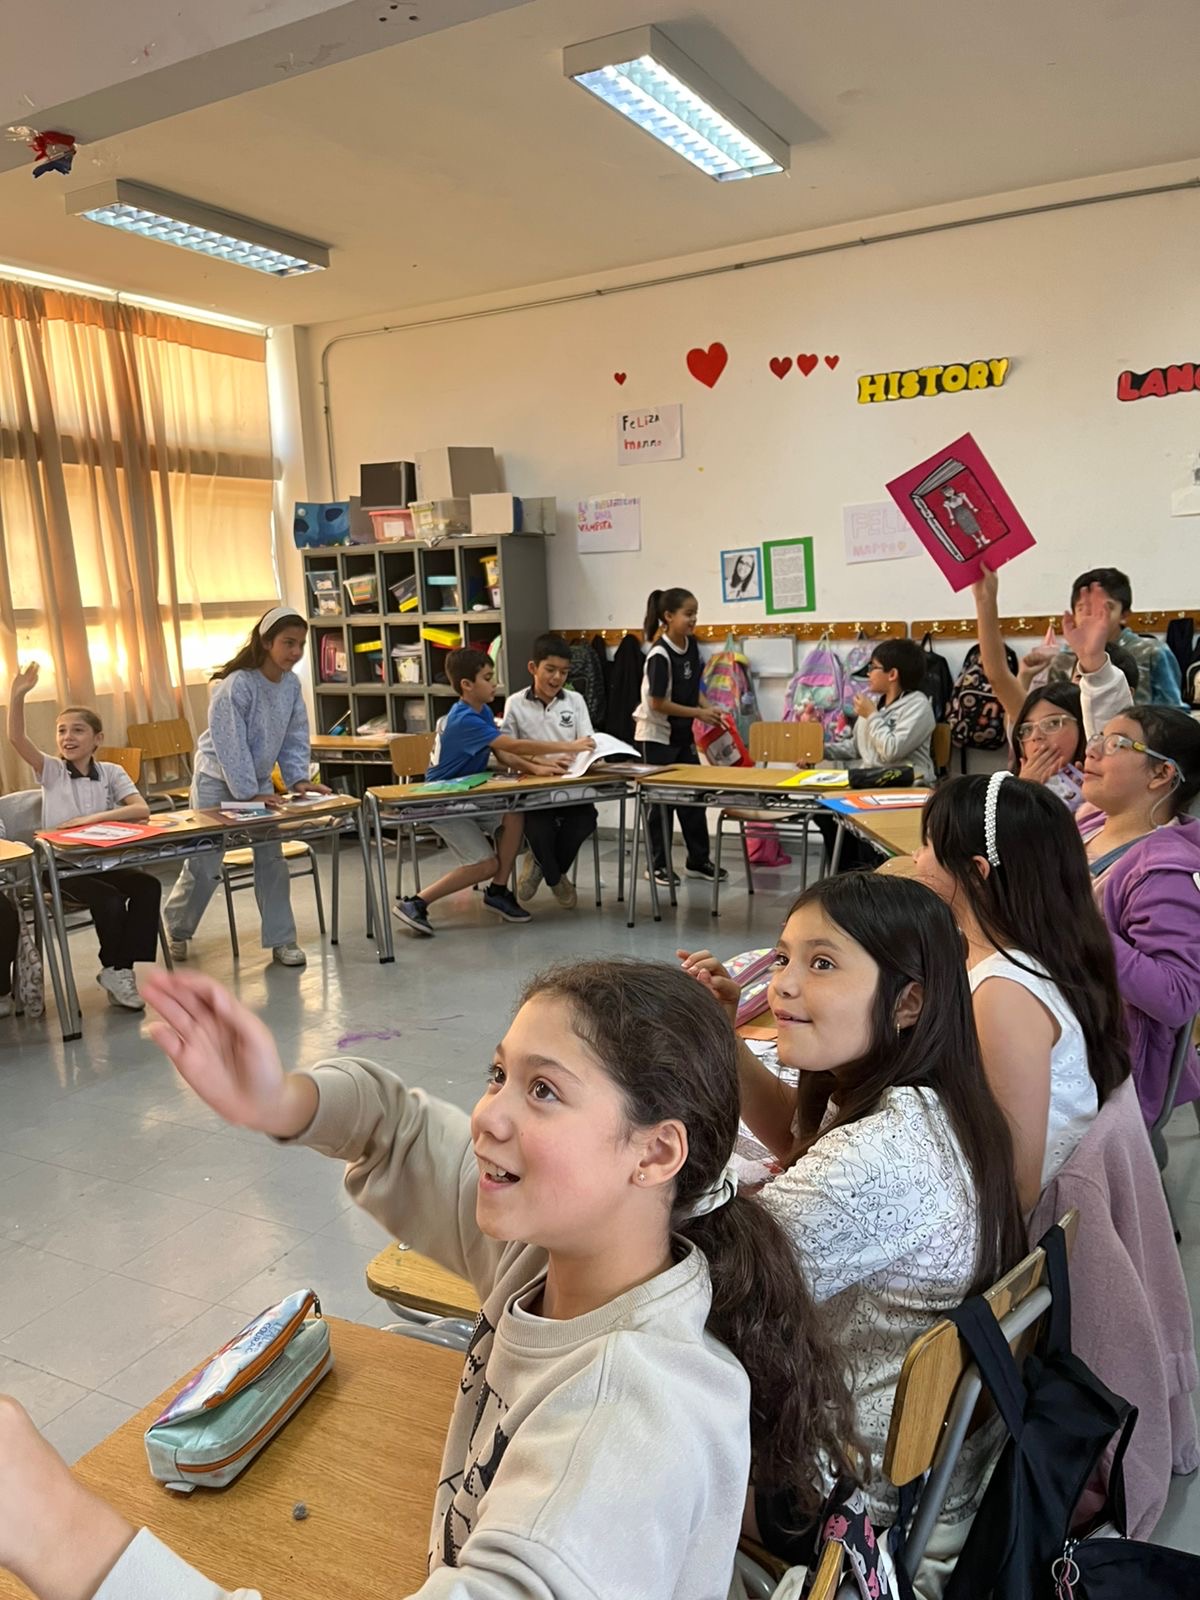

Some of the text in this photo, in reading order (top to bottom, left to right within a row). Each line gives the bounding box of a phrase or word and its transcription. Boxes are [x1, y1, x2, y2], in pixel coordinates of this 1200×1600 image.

[857, 357, 1009, 404] HISTORY
[1117, 362, 1200, 402] LAN
[851, 508, 912, 539] FELI
